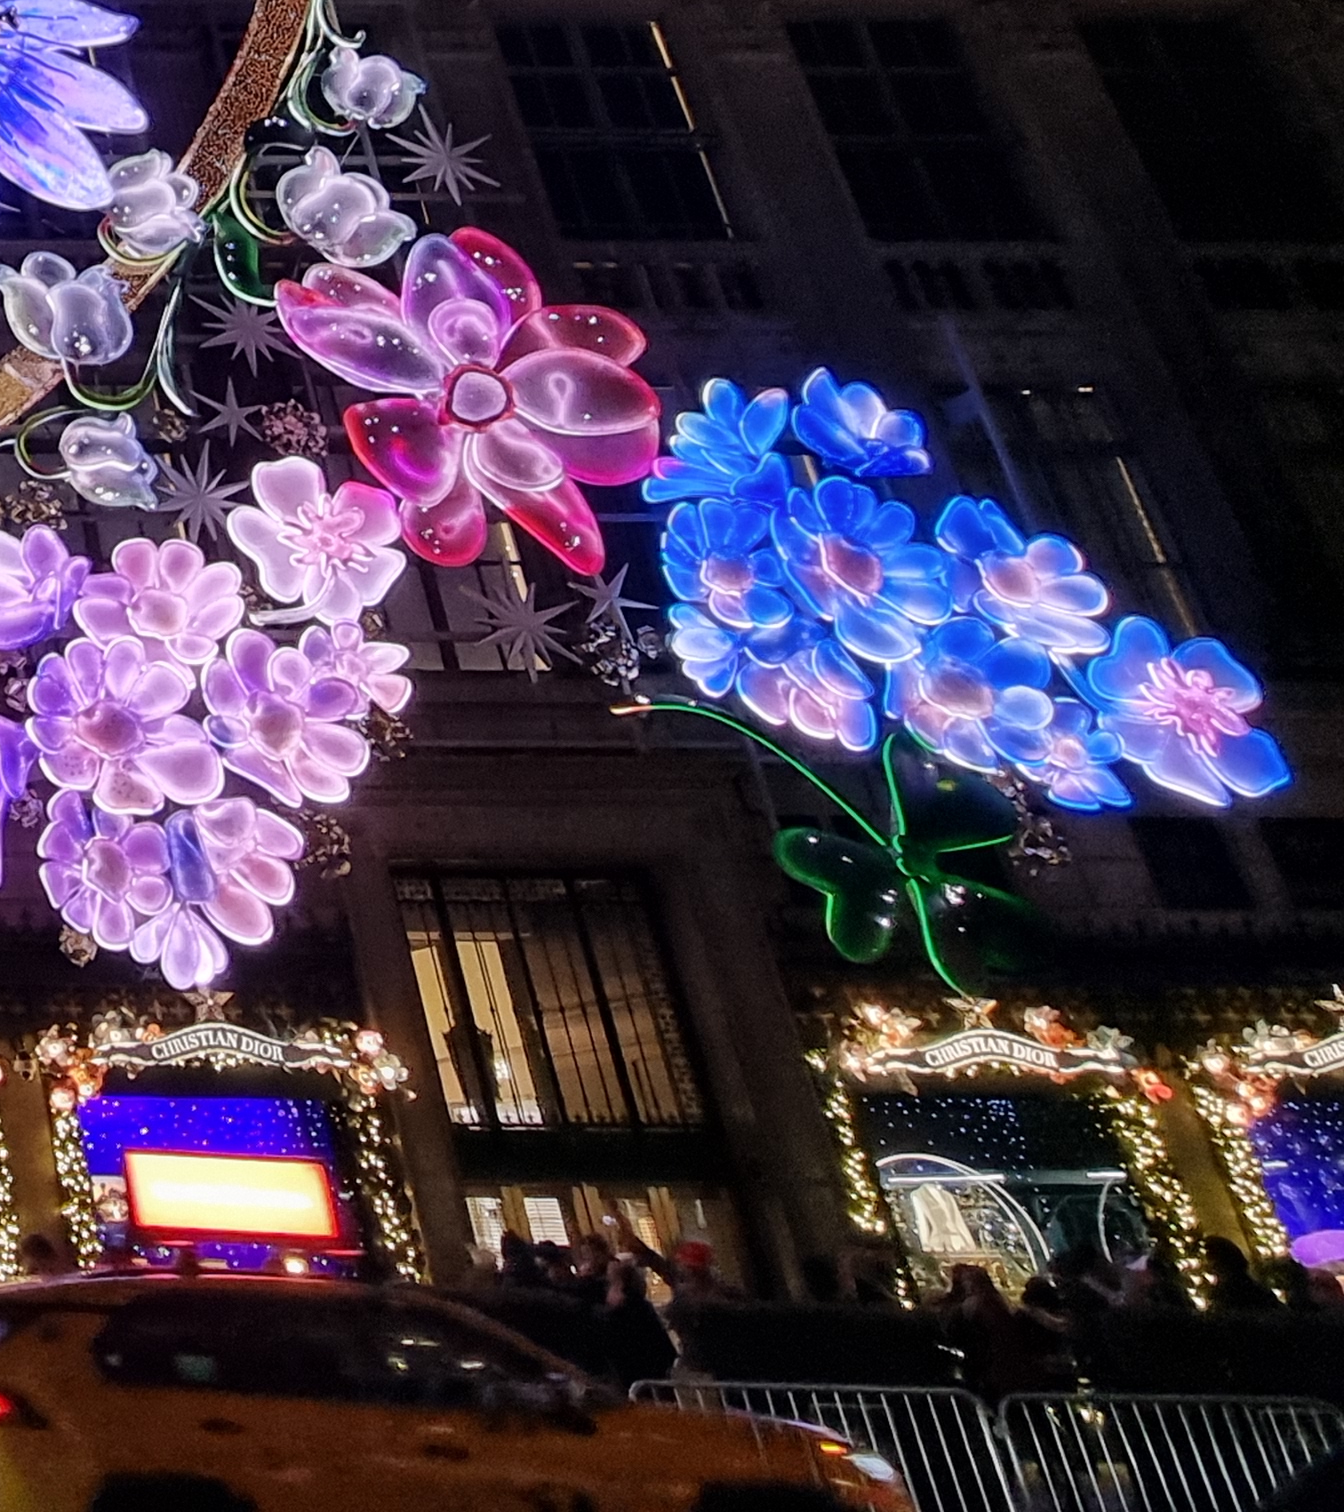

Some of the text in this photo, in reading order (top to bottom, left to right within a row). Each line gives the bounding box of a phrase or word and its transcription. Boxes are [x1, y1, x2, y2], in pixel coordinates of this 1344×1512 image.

[151, 1030, 284, 1061] CHRISTIAN DIOR
[925, 1037, 1059, 1068] CHRISTIAN DIOR
